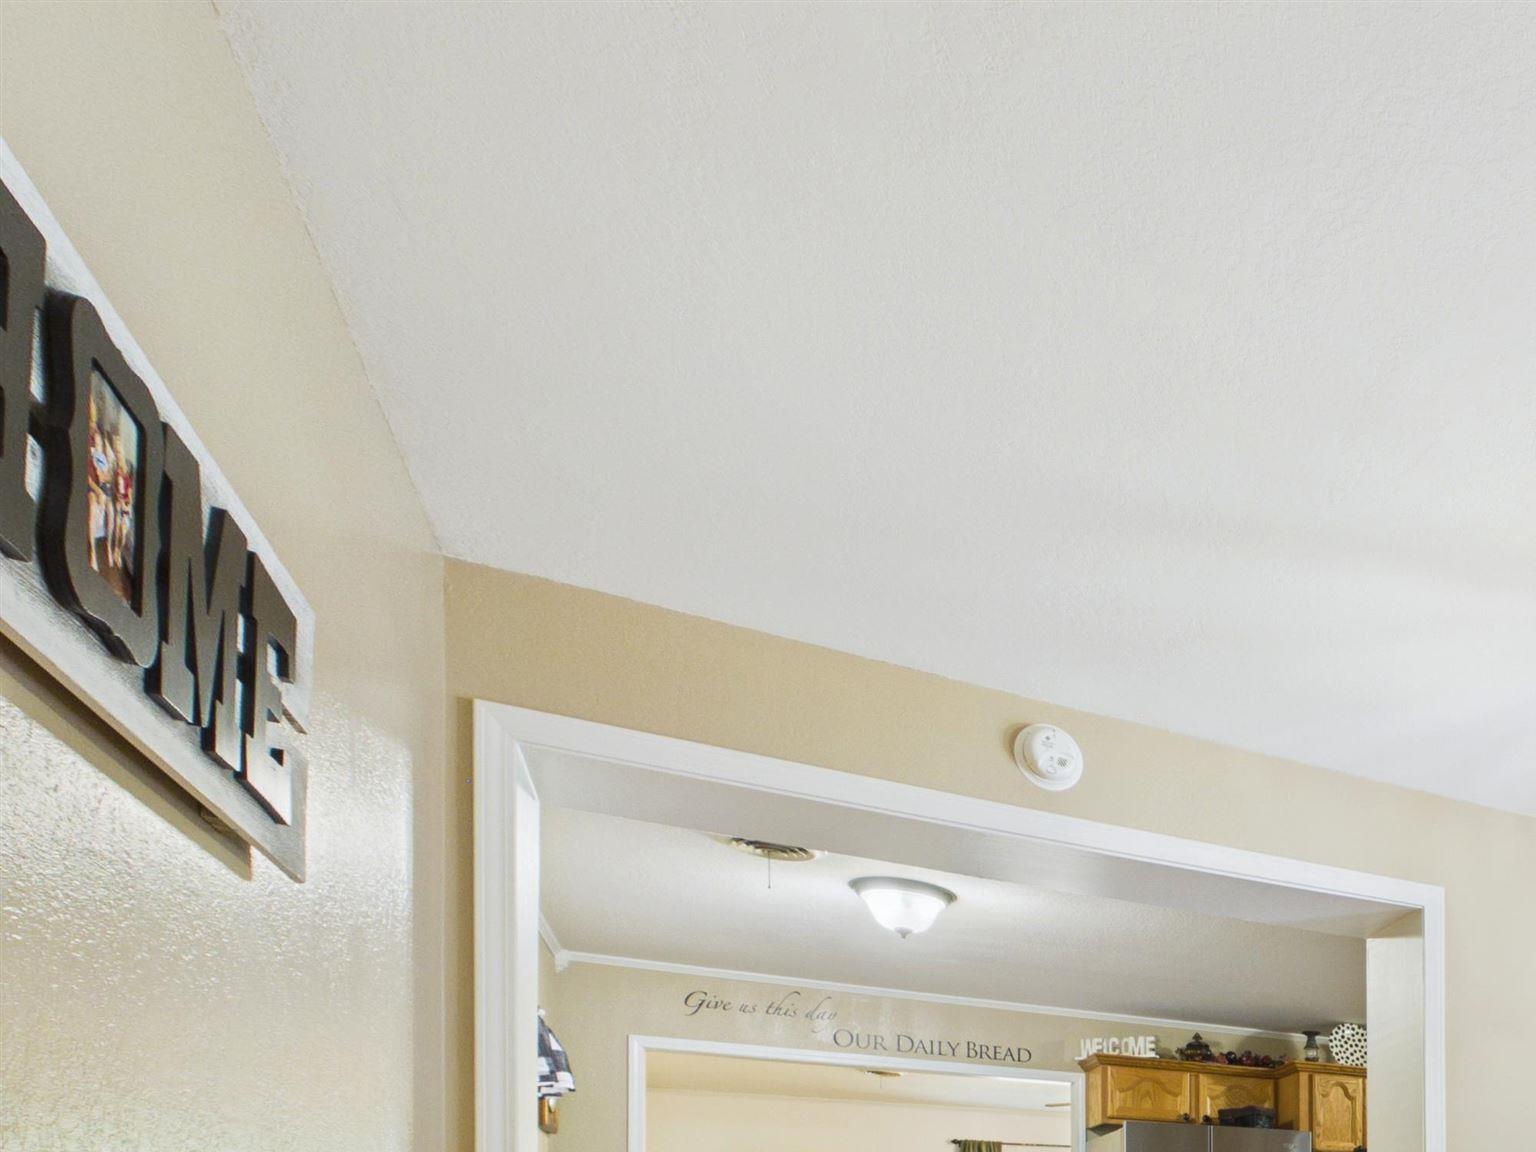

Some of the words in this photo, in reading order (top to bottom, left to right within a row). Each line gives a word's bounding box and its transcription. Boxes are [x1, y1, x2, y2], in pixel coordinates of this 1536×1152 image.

[684, 990, 733, 1016] Give
[739, 1002, 757, 1013] us
[765, 990, 800, 1018] this
[805, 996, 838, 1033] day
[832, 1028, 889, 1051] OUR
[896, 1034, 960, 1057] DAILY
[966, 1041, 1032, 1063] BREAD
[1080, 1036, 1156, 1057] WELCOME
